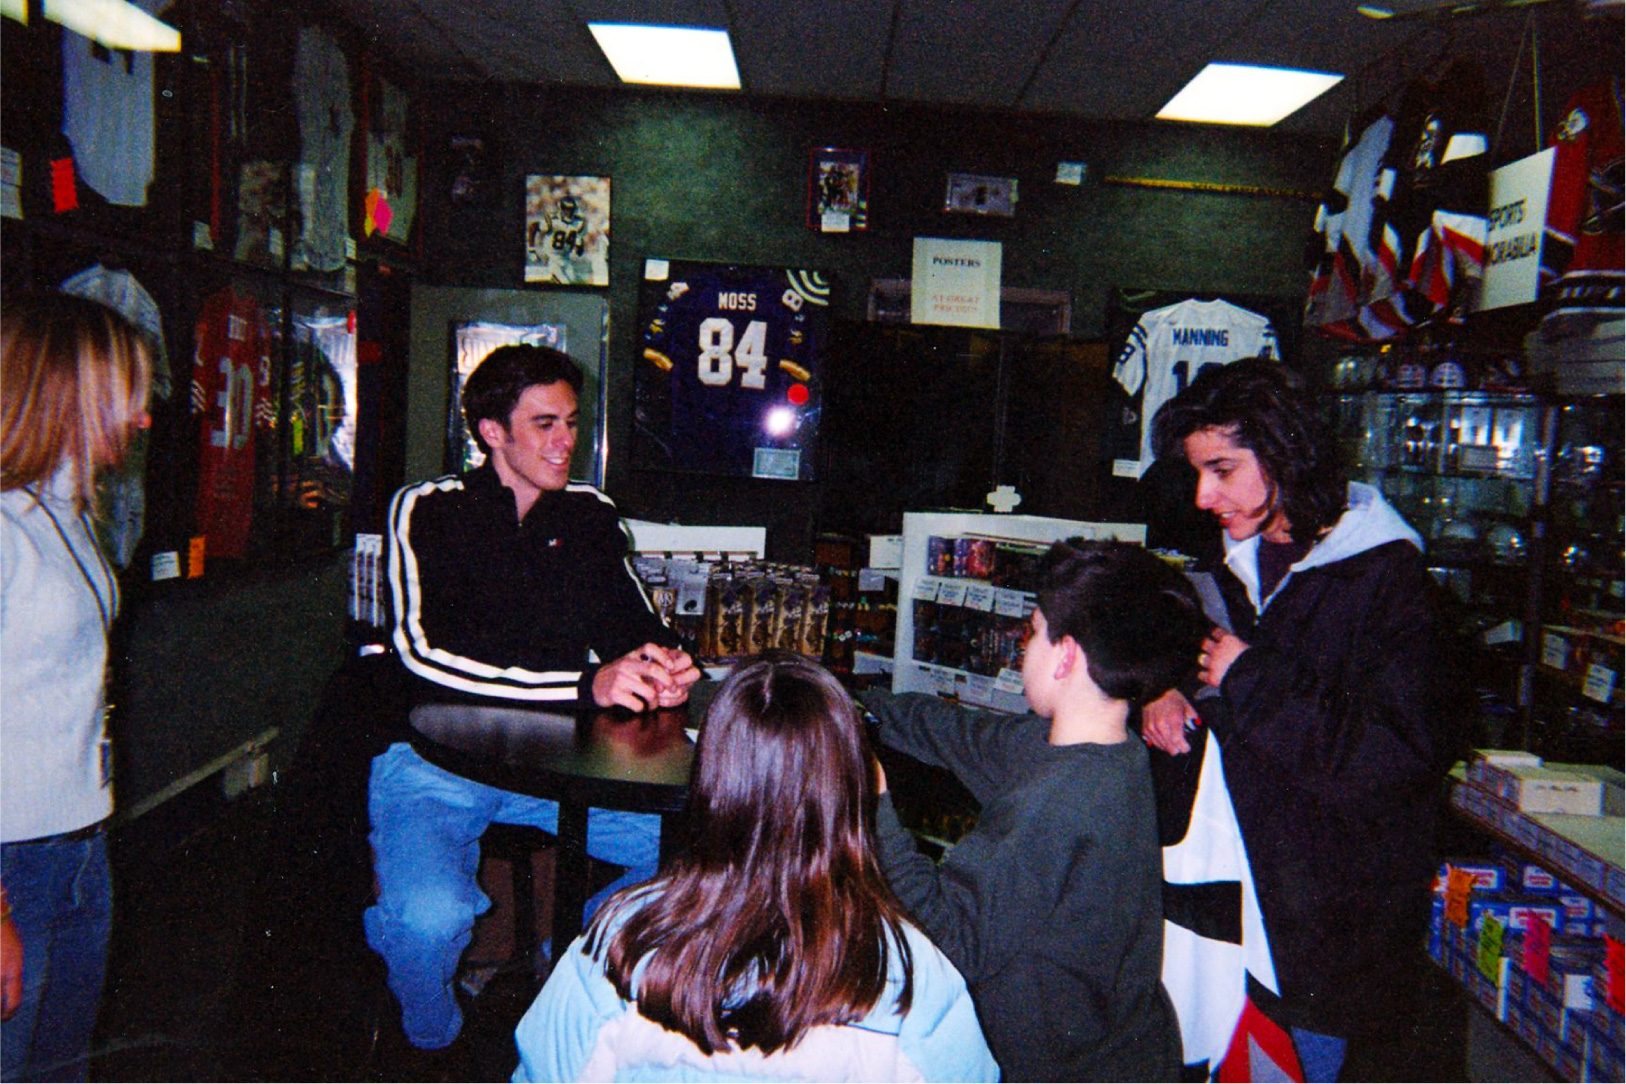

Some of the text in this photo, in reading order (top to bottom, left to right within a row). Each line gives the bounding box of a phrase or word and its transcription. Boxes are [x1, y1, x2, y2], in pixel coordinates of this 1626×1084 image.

[1487, 197, 1526, 233] SPORTS
[552, 230, 579, 252] 84
[932, 256, 981, 267] POSTERS
[717, 291, 758, 312] MOSS
[1172, 328, 1229, 347] MANNING
[698, 316, 768, 389] 84
